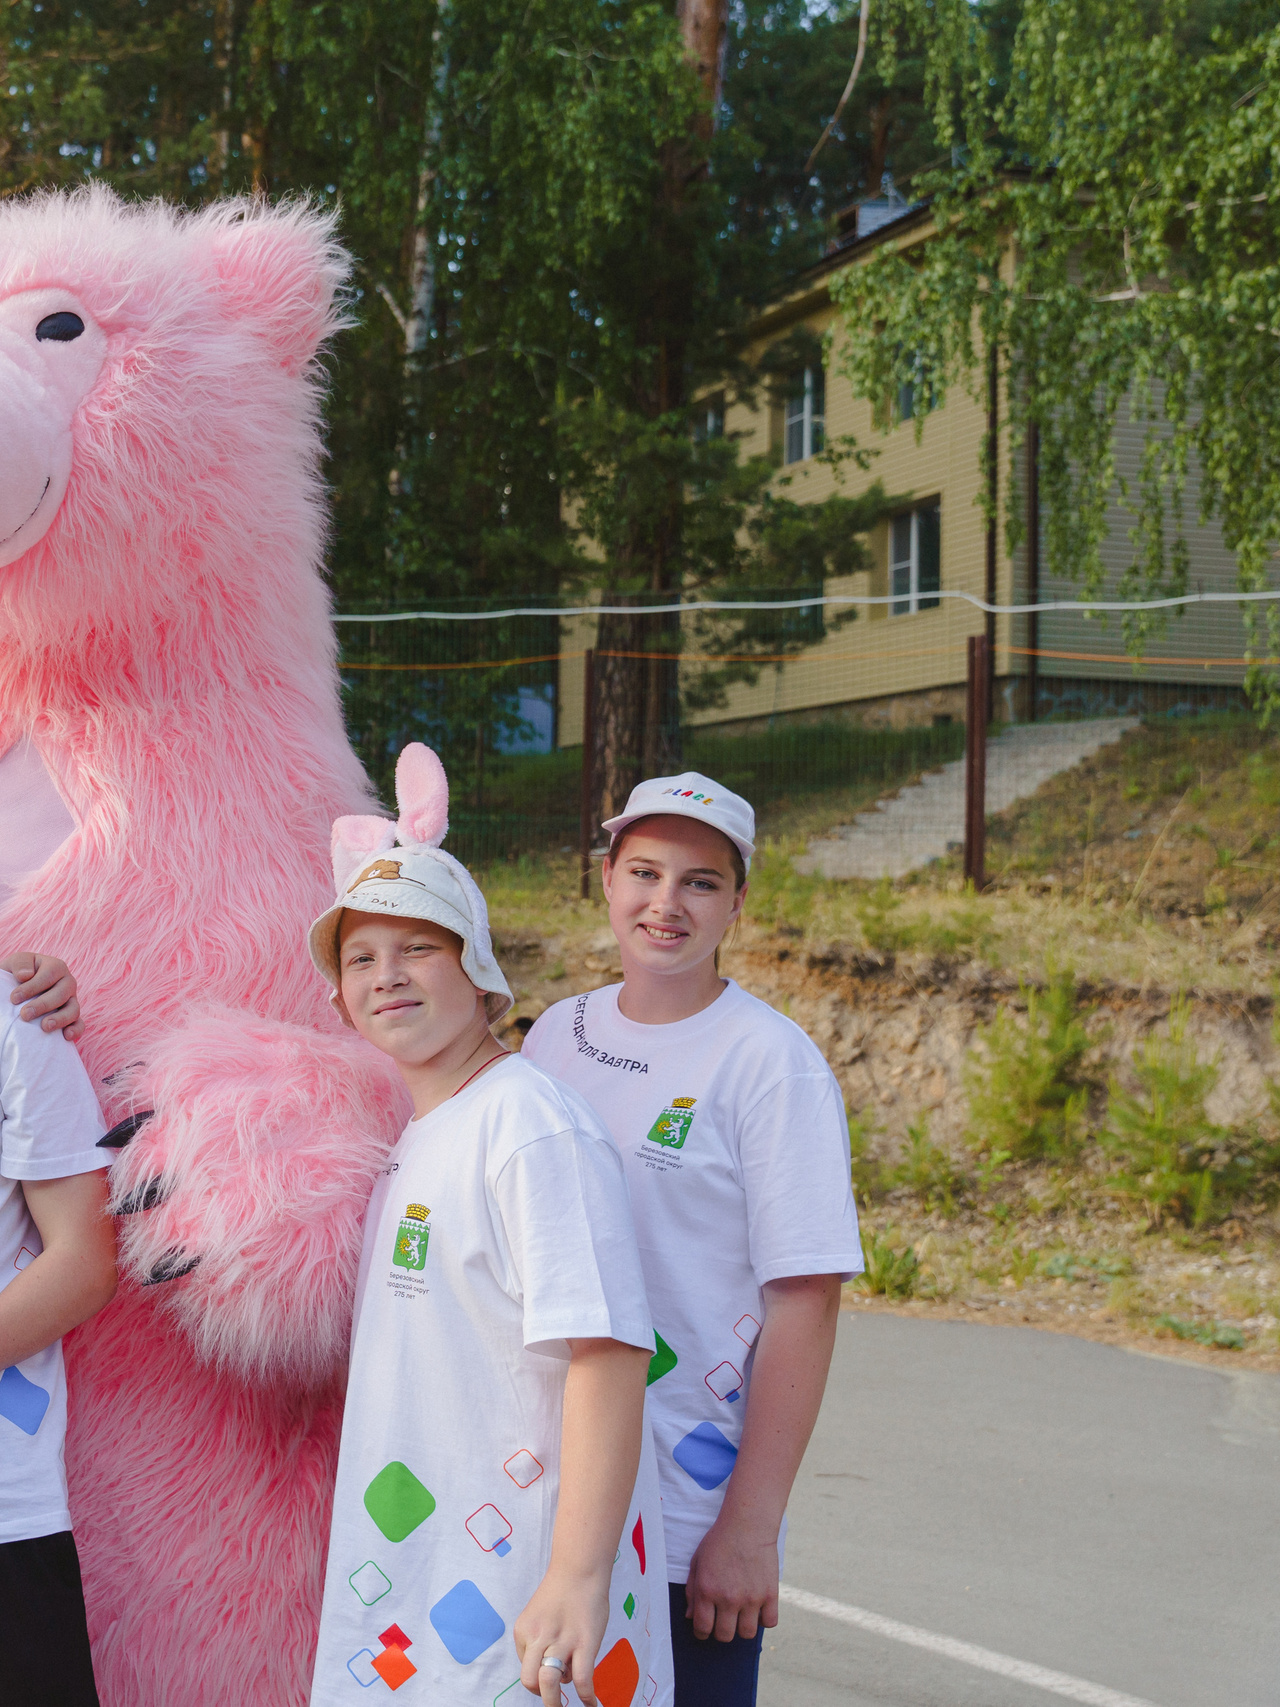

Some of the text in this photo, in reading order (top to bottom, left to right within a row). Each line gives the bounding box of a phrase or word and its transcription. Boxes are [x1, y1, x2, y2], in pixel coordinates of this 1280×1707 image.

[661, 788, 714, 805] PLACE
[597, 1051, 649, 1074] ЗАВТРА
[640, 1144, 680, 1161] Березовский
[634, 1151, 683, 1170] городской округ
[645, 1161, 656, 1169] 275
[389, 1271, 425, 1285] Березовский
[394, 1290, 405, 1298] 275
[413, 1286, 430, 1295] округ
